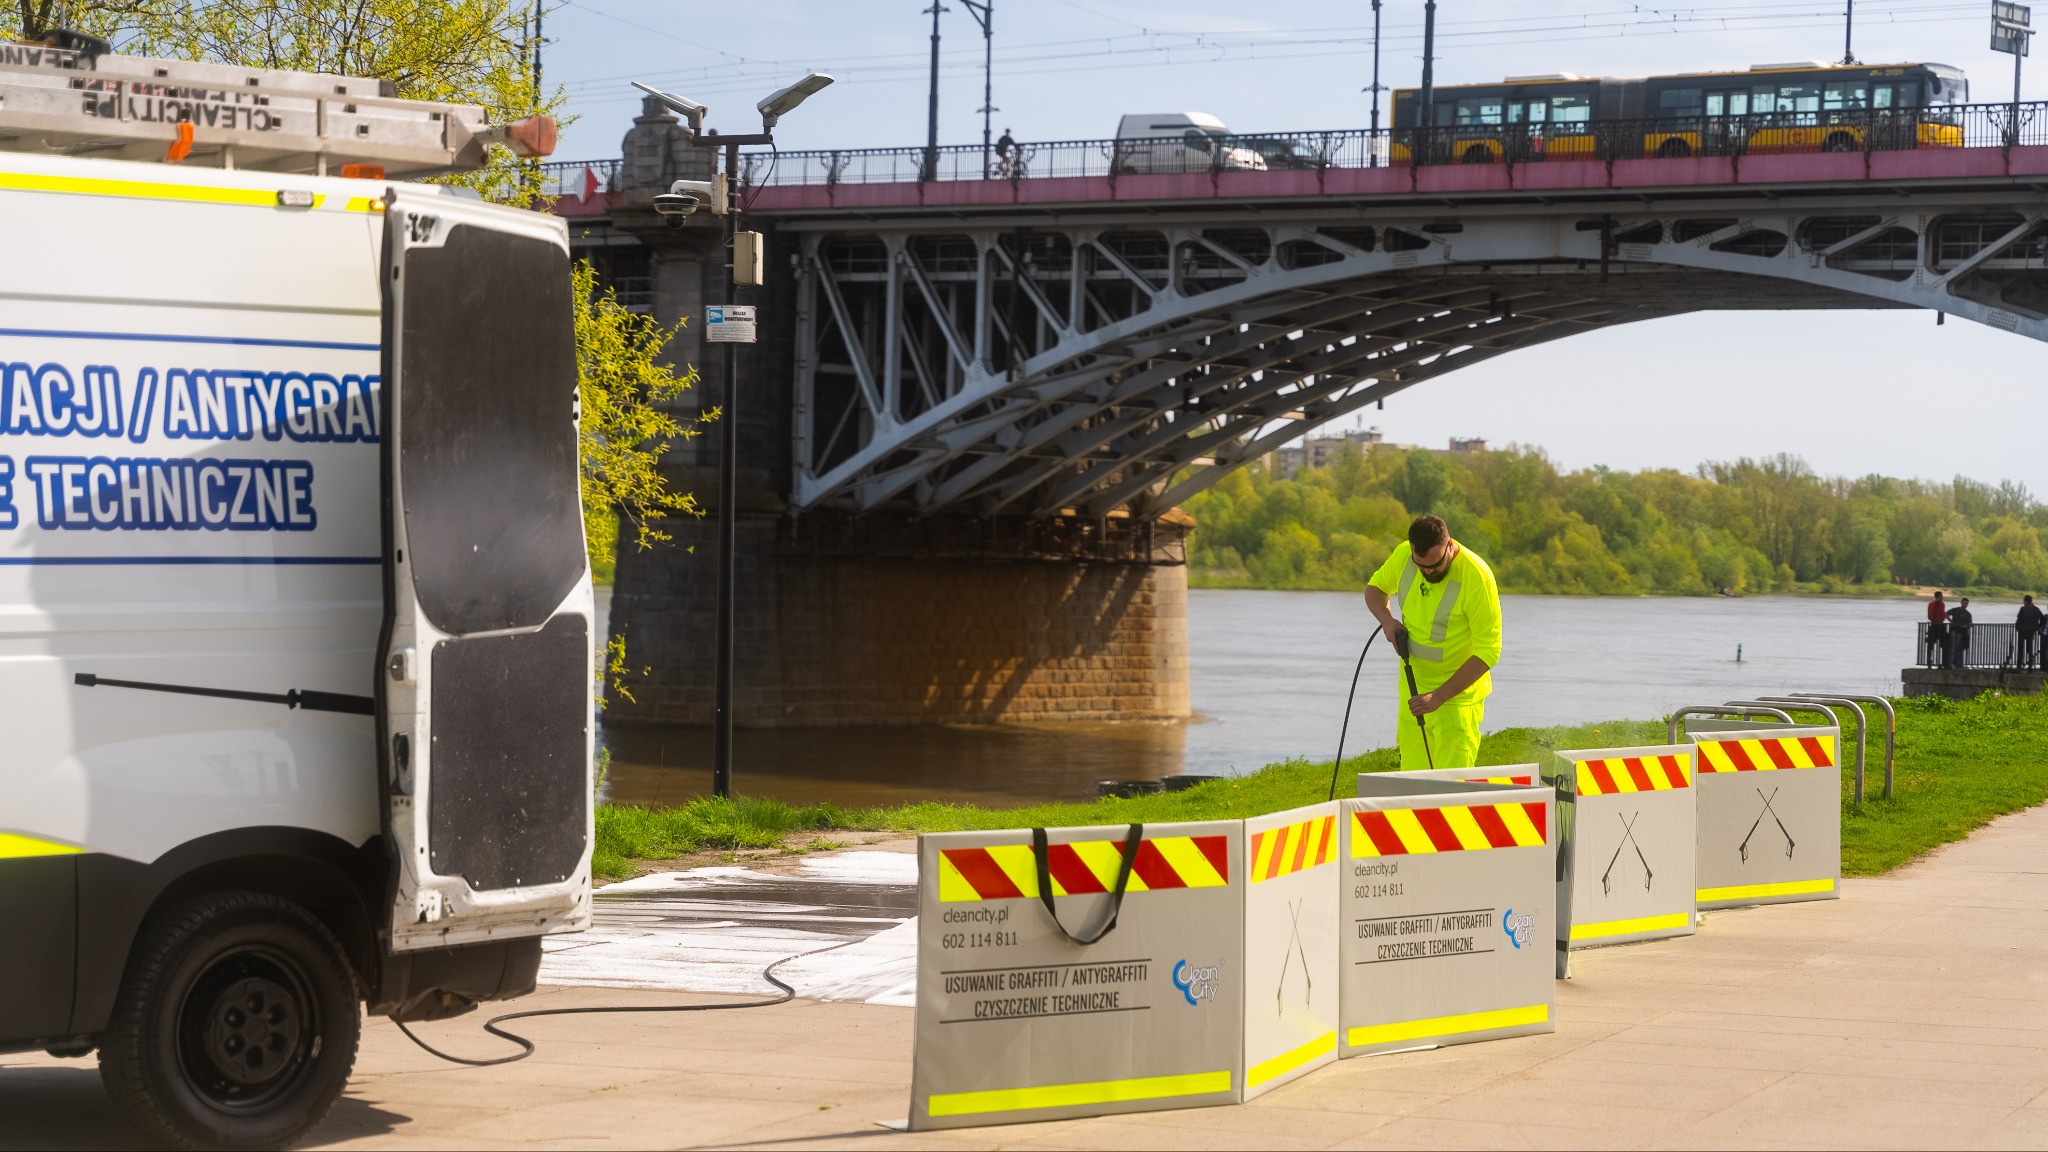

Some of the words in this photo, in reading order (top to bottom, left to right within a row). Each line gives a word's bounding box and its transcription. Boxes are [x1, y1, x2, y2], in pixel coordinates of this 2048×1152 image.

[0, 362, 124, 437] ACJI
[25, 456, 317, 531] TECHNICZNE
[1355, 861, 1398, 877] cleancity.pl
[1355, 886, 1370, 899] 602
[1373, 884, 1387, 897] 114
[1390, 883, 1403, 895] 811
[943, 906, 1009, 925] cleancity.pl
[1358, 921, 1397, 939] USUWANIE
[1400, 918, 1433, 935] GRAFFITI
[1434, 916, 1440, 934] /
[1441, 913, 1492, 932] ANTYGRAFFITI
[943, 933, 965, 949] 602
[970, 932, 992, 948] 114
[995, 930, 1018, 947] 811
[1377, 941, 1426, 960] CZYSZCZENIE
[1428, 936, 1474, 955] TECHNICZNE
[945, 973, 1005, 994] USUWANIE
[1009, 970, 1058, 990] GRAFFITI
[1061, 968, 1070, 988] /
[1072, 964, 1148, 987] ANTYGRAFFITI
[1177, 963, 1219, 985] Clean
[1188, 981, 1219, 1003] City
[974, 996, 1048, 1018] CZYSZCZENIE
[1052, 991, 1120, 1012] TECHNICZNE
